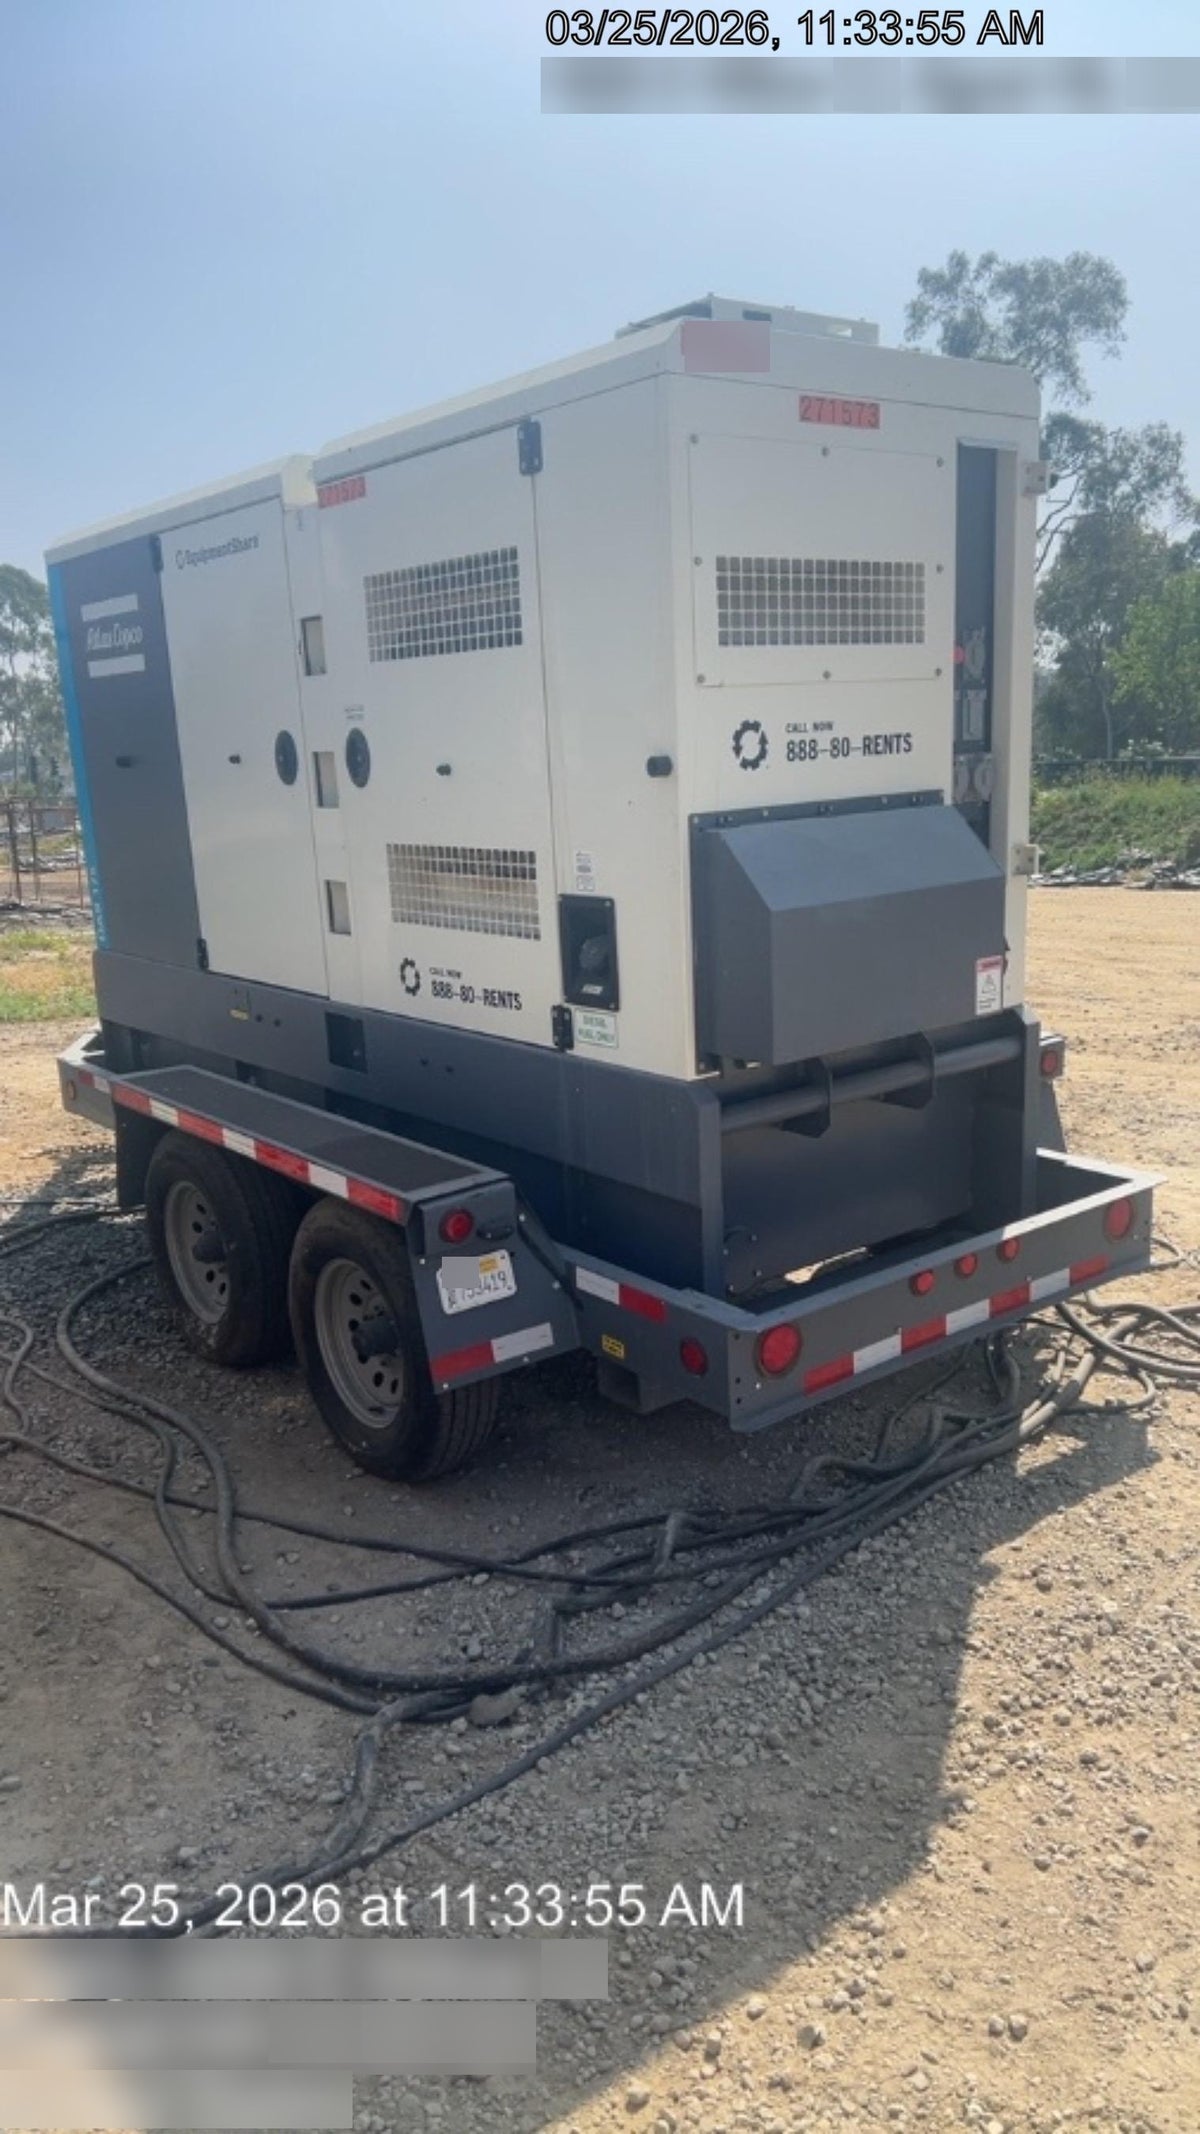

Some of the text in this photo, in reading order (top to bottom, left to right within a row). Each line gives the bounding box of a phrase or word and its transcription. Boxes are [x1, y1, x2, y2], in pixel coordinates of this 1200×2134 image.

[799, 395, 880, 430] 271573
[785, 721, 833, 733] CALL NOW
[786, 732, 912, 762] 888-80-RENTS
[431, 980, 523, 1011] 888-80-RENTS
